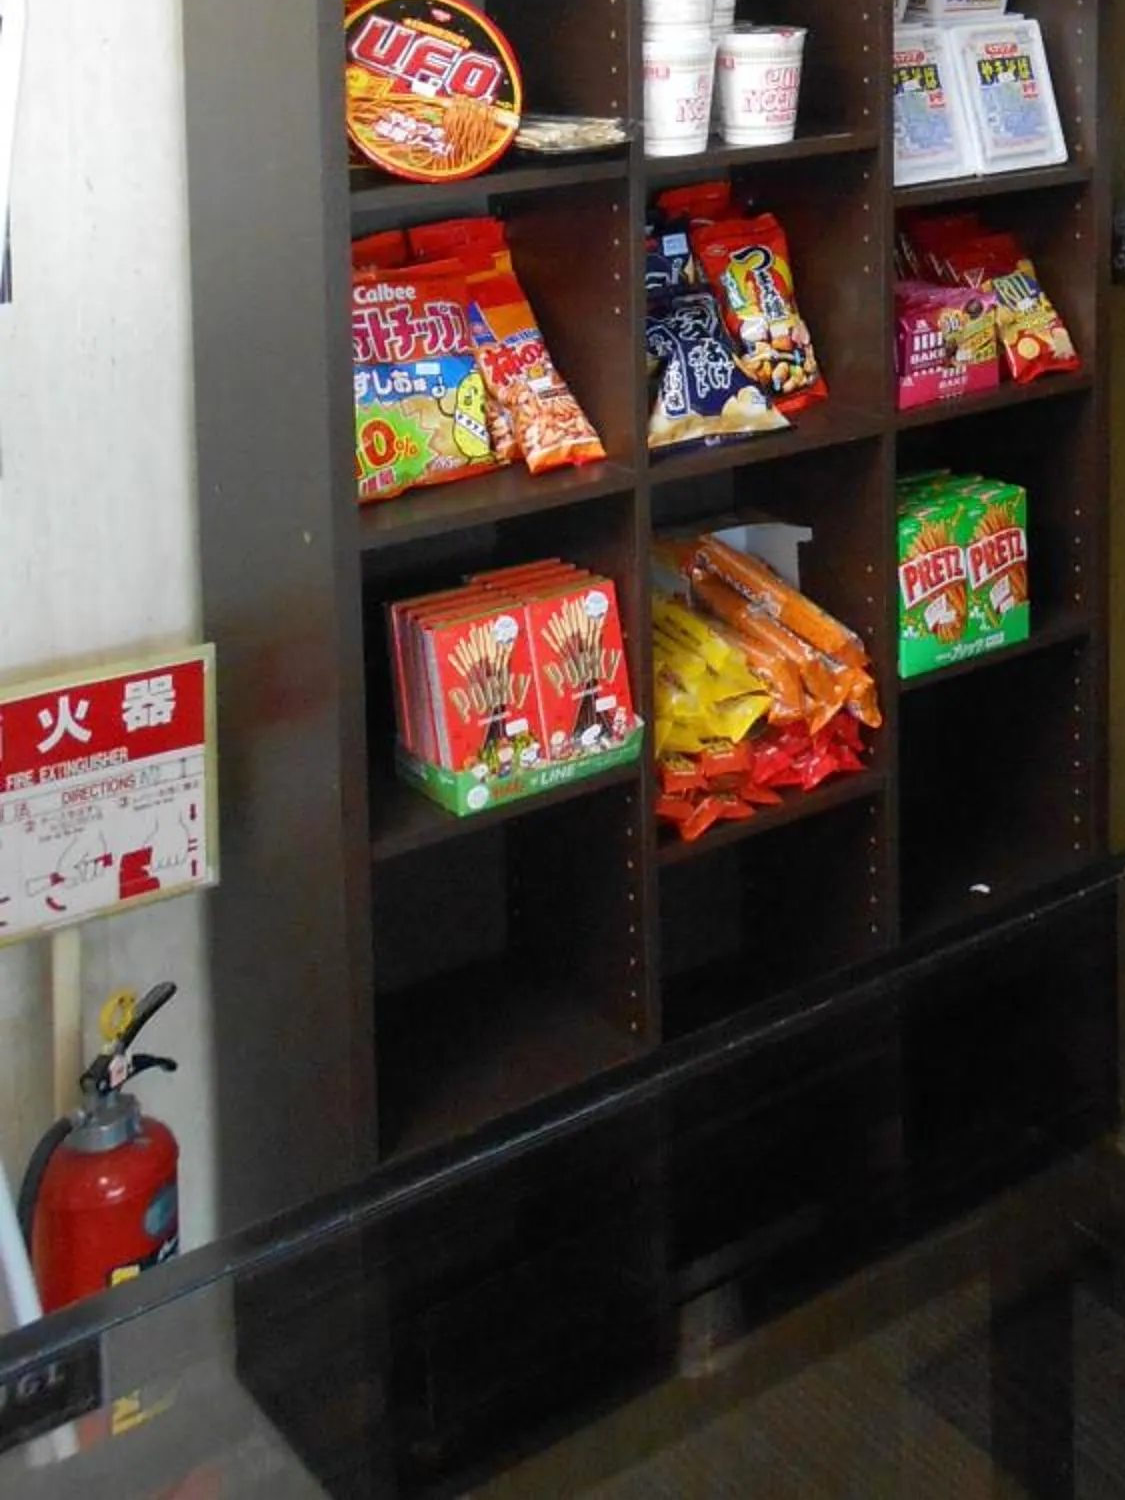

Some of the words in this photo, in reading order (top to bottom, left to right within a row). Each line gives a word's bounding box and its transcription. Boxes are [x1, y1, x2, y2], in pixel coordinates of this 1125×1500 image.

[353, 283, 417, 305] Calbee
[902, 548, 963, 604] PRETZ
[971, 529, 1024, 584] PRETZ
[0, 674, 177, 760] 火器
[61, 773, 136, 805] DIRECTIONS
